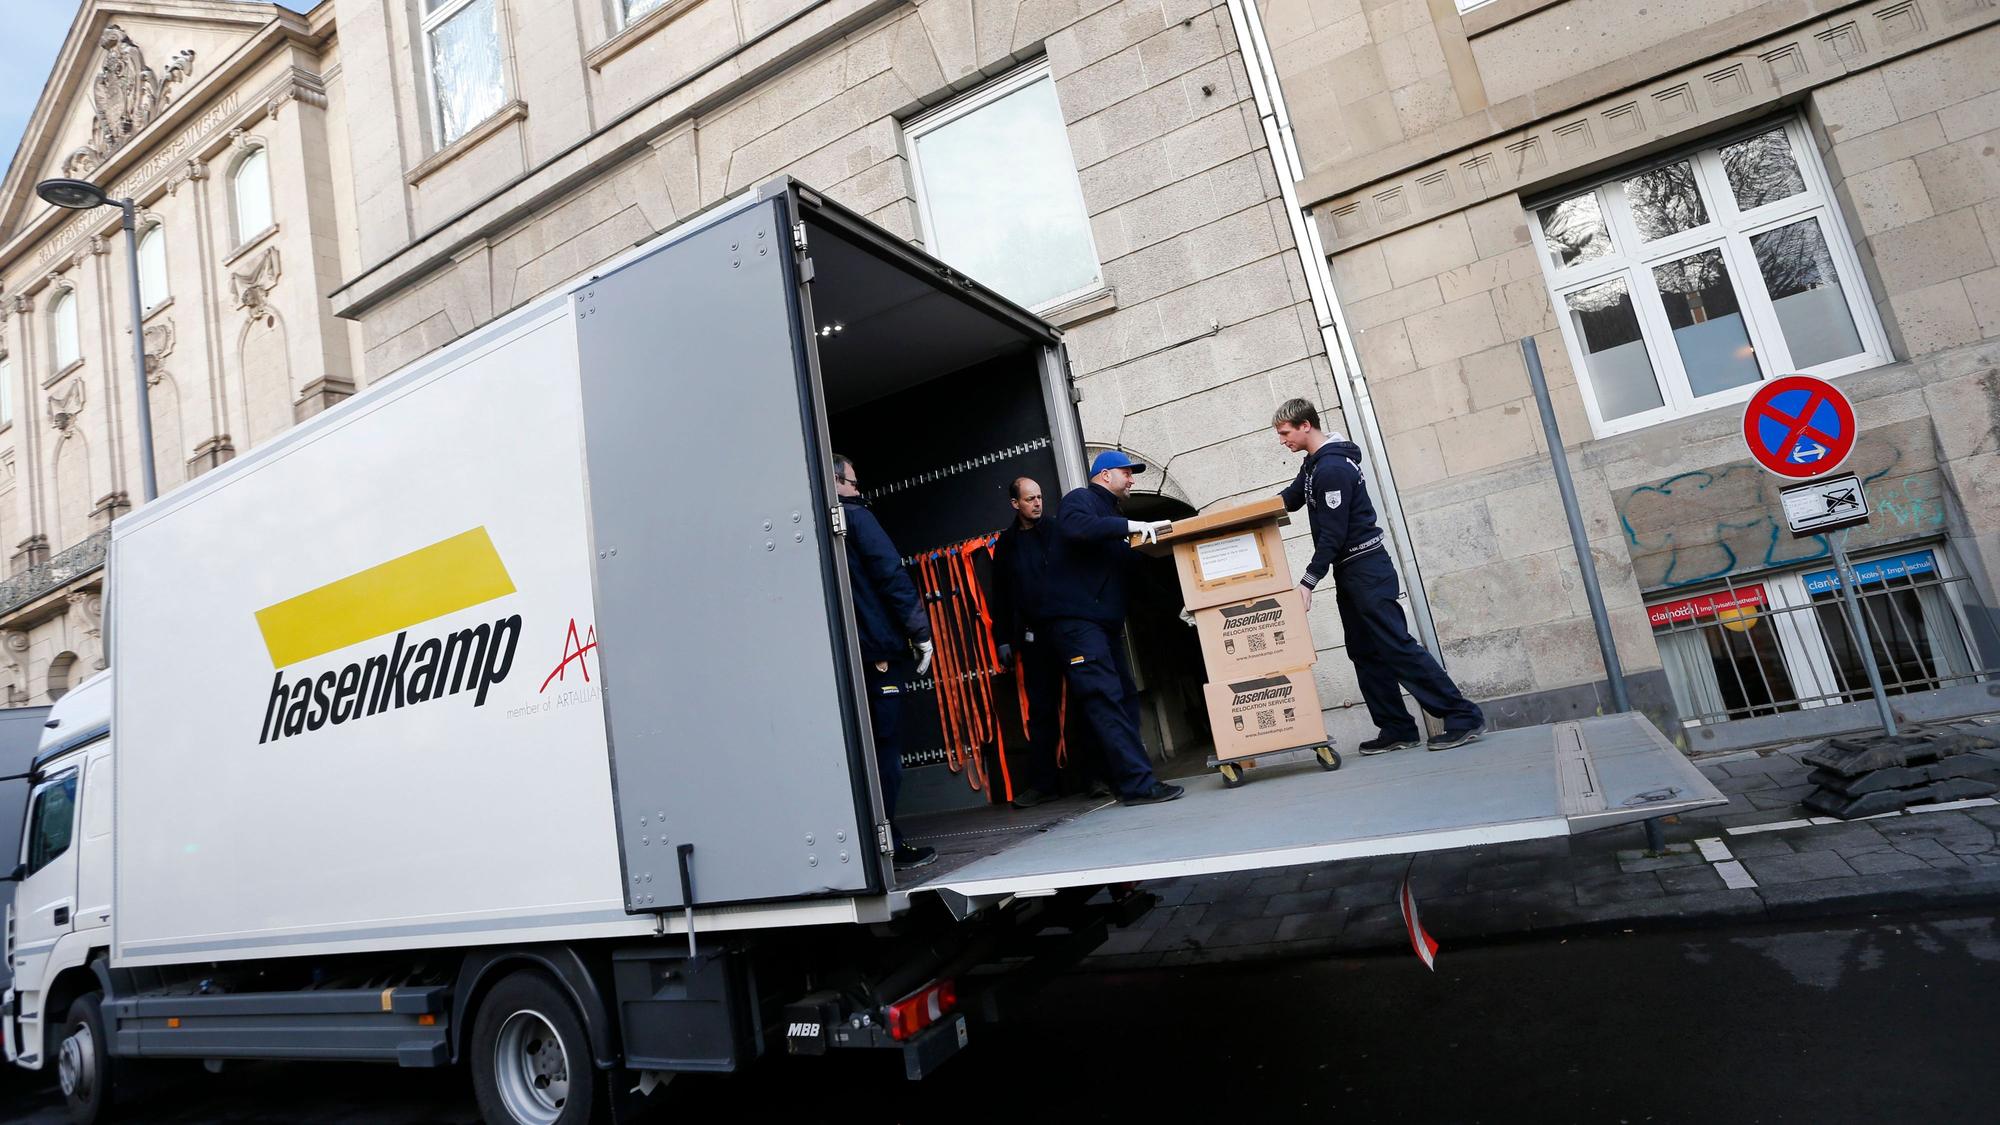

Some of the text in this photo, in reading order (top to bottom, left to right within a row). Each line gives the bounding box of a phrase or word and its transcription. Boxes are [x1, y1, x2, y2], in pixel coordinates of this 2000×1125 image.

[1222, 620, 1286, 637] RELOCATION SERVICES
[1223, 609, 1282, 630] hasenkamp
[258, 614, 522, 744] hasenkamp
[1231, 696, 1296, 713] RELOCATION SERVICES
[1232, 685, 1293, 706] hasenkamp
[506, 701, 540, 719] member
[543, 695, 552, 712] of
[787, 1022, 820, 1037] MBB
